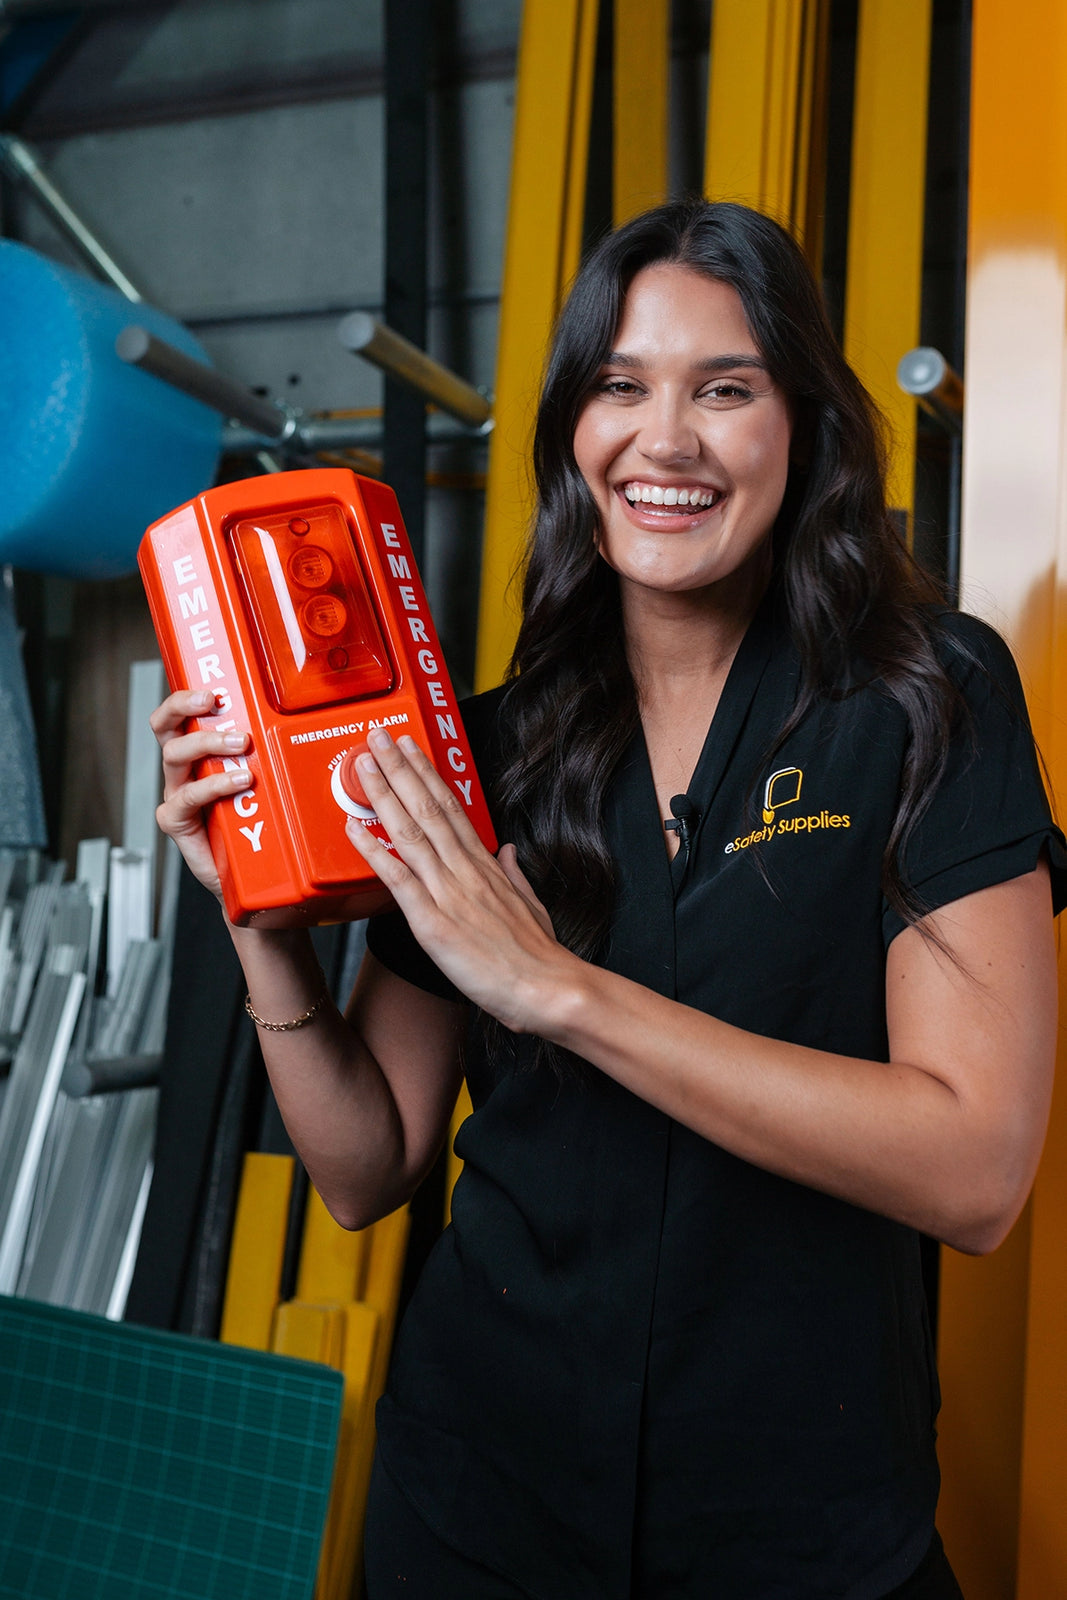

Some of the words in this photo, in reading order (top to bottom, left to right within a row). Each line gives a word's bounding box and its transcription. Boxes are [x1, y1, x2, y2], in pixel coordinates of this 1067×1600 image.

[381, 523, 472, 806] EMERGENCY
[290, 722, 364, 744] EMERGENCY
[368, 713, 409, 730] ALARM
[328, 749, 348, 771] PUSH
[724, 824, 776, 854] eSafety
